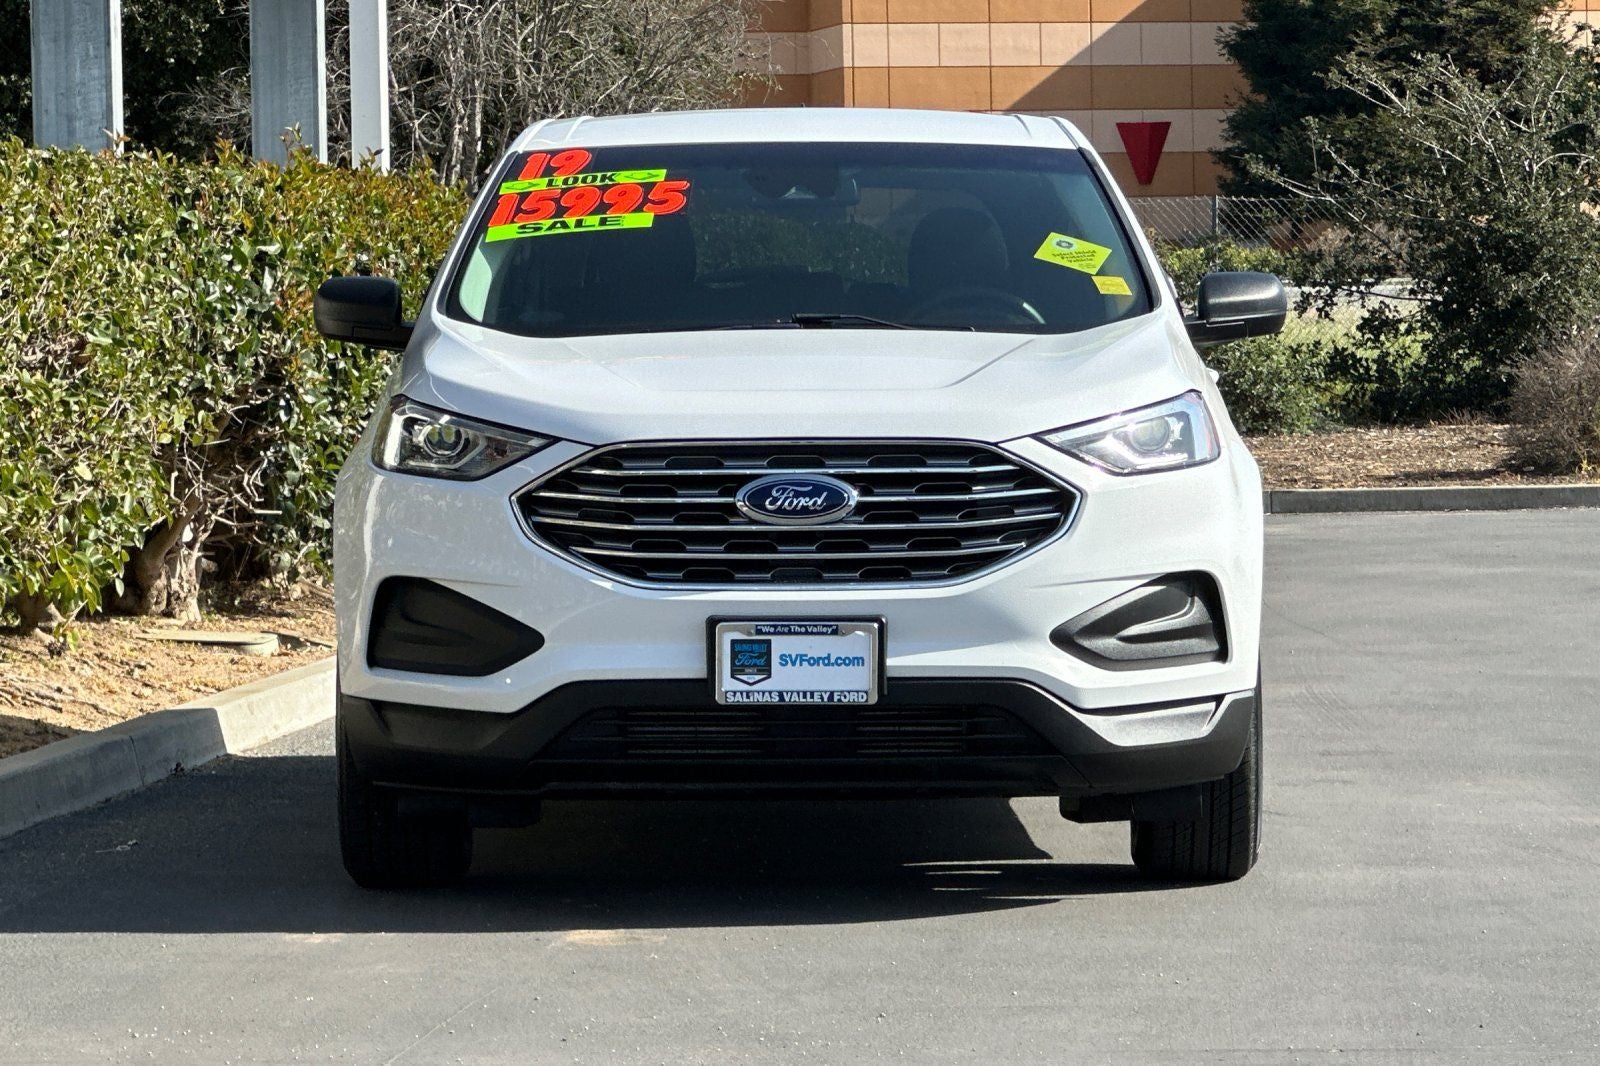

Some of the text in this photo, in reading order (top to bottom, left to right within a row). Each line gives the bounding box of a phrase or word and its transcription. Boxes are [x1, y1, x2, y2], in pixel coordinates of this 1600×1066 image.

[518, 149, 592, 180] 19
[546, 172, 617, 187] LOOK
[487, 180, 690, 226] 15995
[515, 215, 621, 235] SALE
[764, 484, 828, 511] Ford
[776, 625, 789, 633] Are
[790, 625, 806, 633] The
[734, 652, 767, 666] Ford
[778, 653, 865, 667] SVFord.com
[726, 692, 867, 703] SALINAS VALLEY FORD
